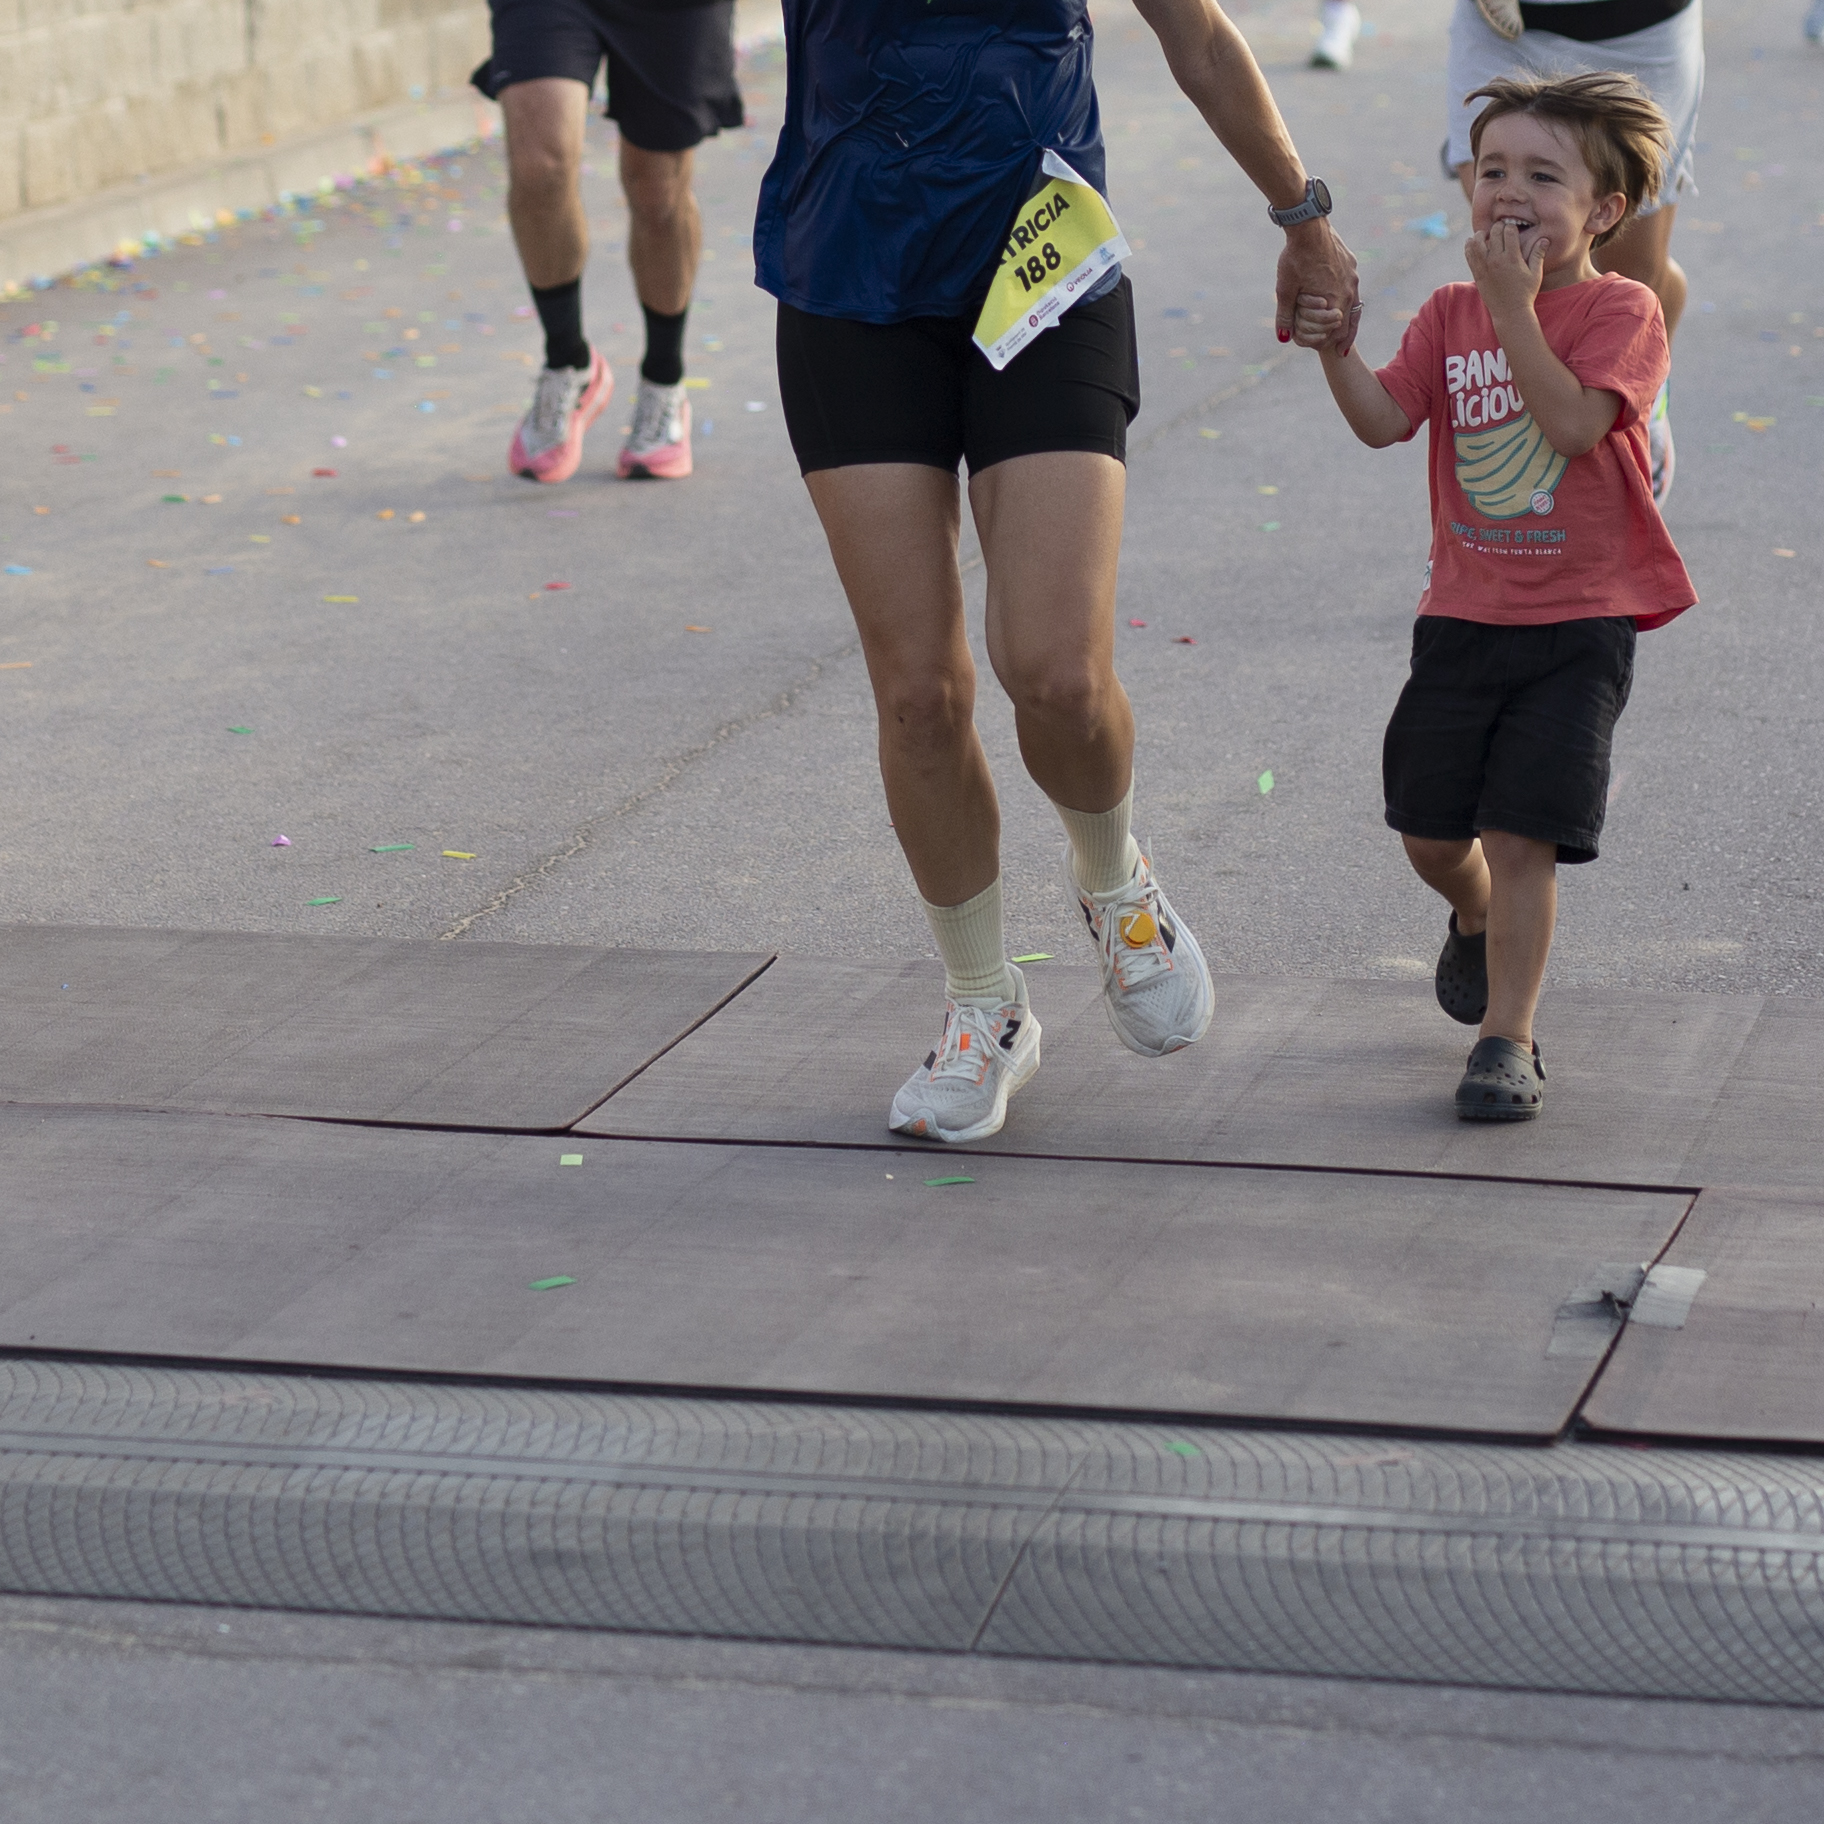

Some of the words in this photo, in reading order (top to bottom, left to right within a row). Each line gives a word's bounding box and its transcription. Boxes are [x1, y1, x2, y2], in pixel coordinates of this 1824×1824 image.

[1014, 242, 1061, 292] 188
[1074, 268, 1093, 285] VEOLIA
[1479, 528, 1511, 543] SWEET
[1526, 529, 1566, 543] FRESH
